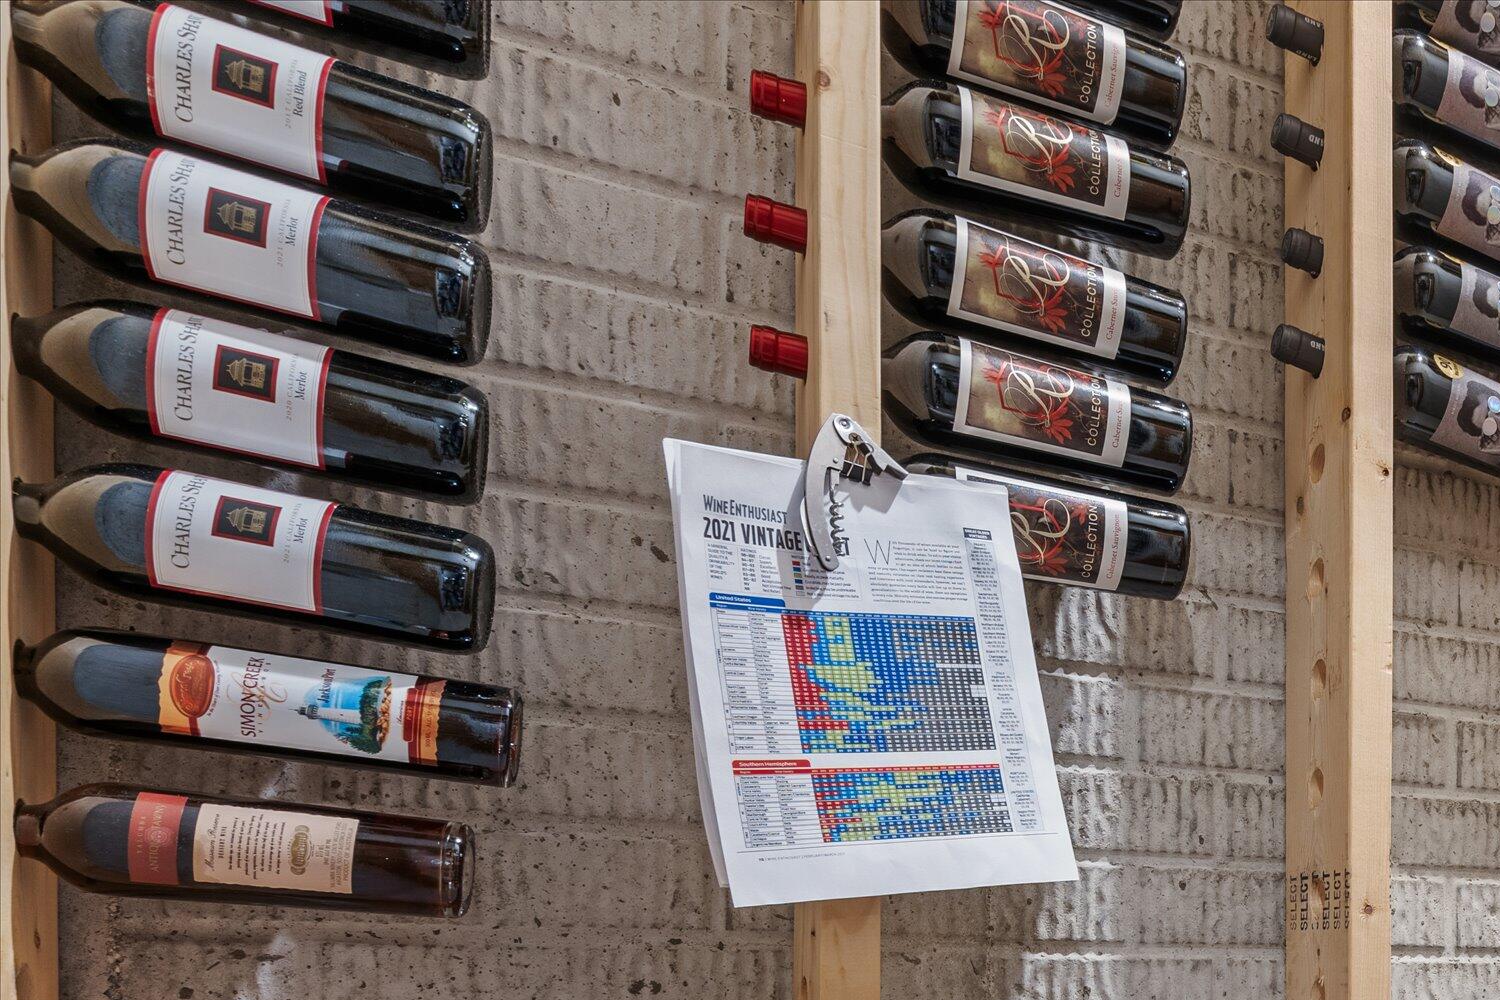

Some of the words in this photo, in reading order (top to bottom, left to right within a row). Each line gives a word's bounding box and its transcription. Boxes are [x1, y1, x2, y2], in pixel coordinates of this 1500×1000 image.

[174, 41, 194, 123] CHARLES
[1080, 23, 1097, 103] COLLECTION
[293, 71, 307, 96] Blend
[292, 97, 305, 117] Red
[166, 187, 185, 266] CHARLES
[285, 216, 299, 247] Merlot
[1081, 265, 1097, 338] COLLECTION
[1105, 306, 1117, 340] Cabernet
[174, 344, 194, 422] CHARLES
[294, 370, 308, 400] Merlot
[1087, 378, 1102, 446] COLLECTION
[1111, 415, 1122, 448] Cabernet
[171, 495, 193, 569] CHARLES
[293, 517, 308, 544] Merlot
[703, 517, 736, 542] 2021
[740, 523, 803, 551] VINTAGE
[1081, 504, 1098, 578] COLLECTION
[1106, 550, 1119, 580] Cabernet
[715, 594, 733, 602] United
[244, 656, 266, 689] CREEK
[240, 693, 258, 738] SIMON
[1300, 871, 1308, 931] SELECT
[1333, 870, 1341, 930] SELECT
